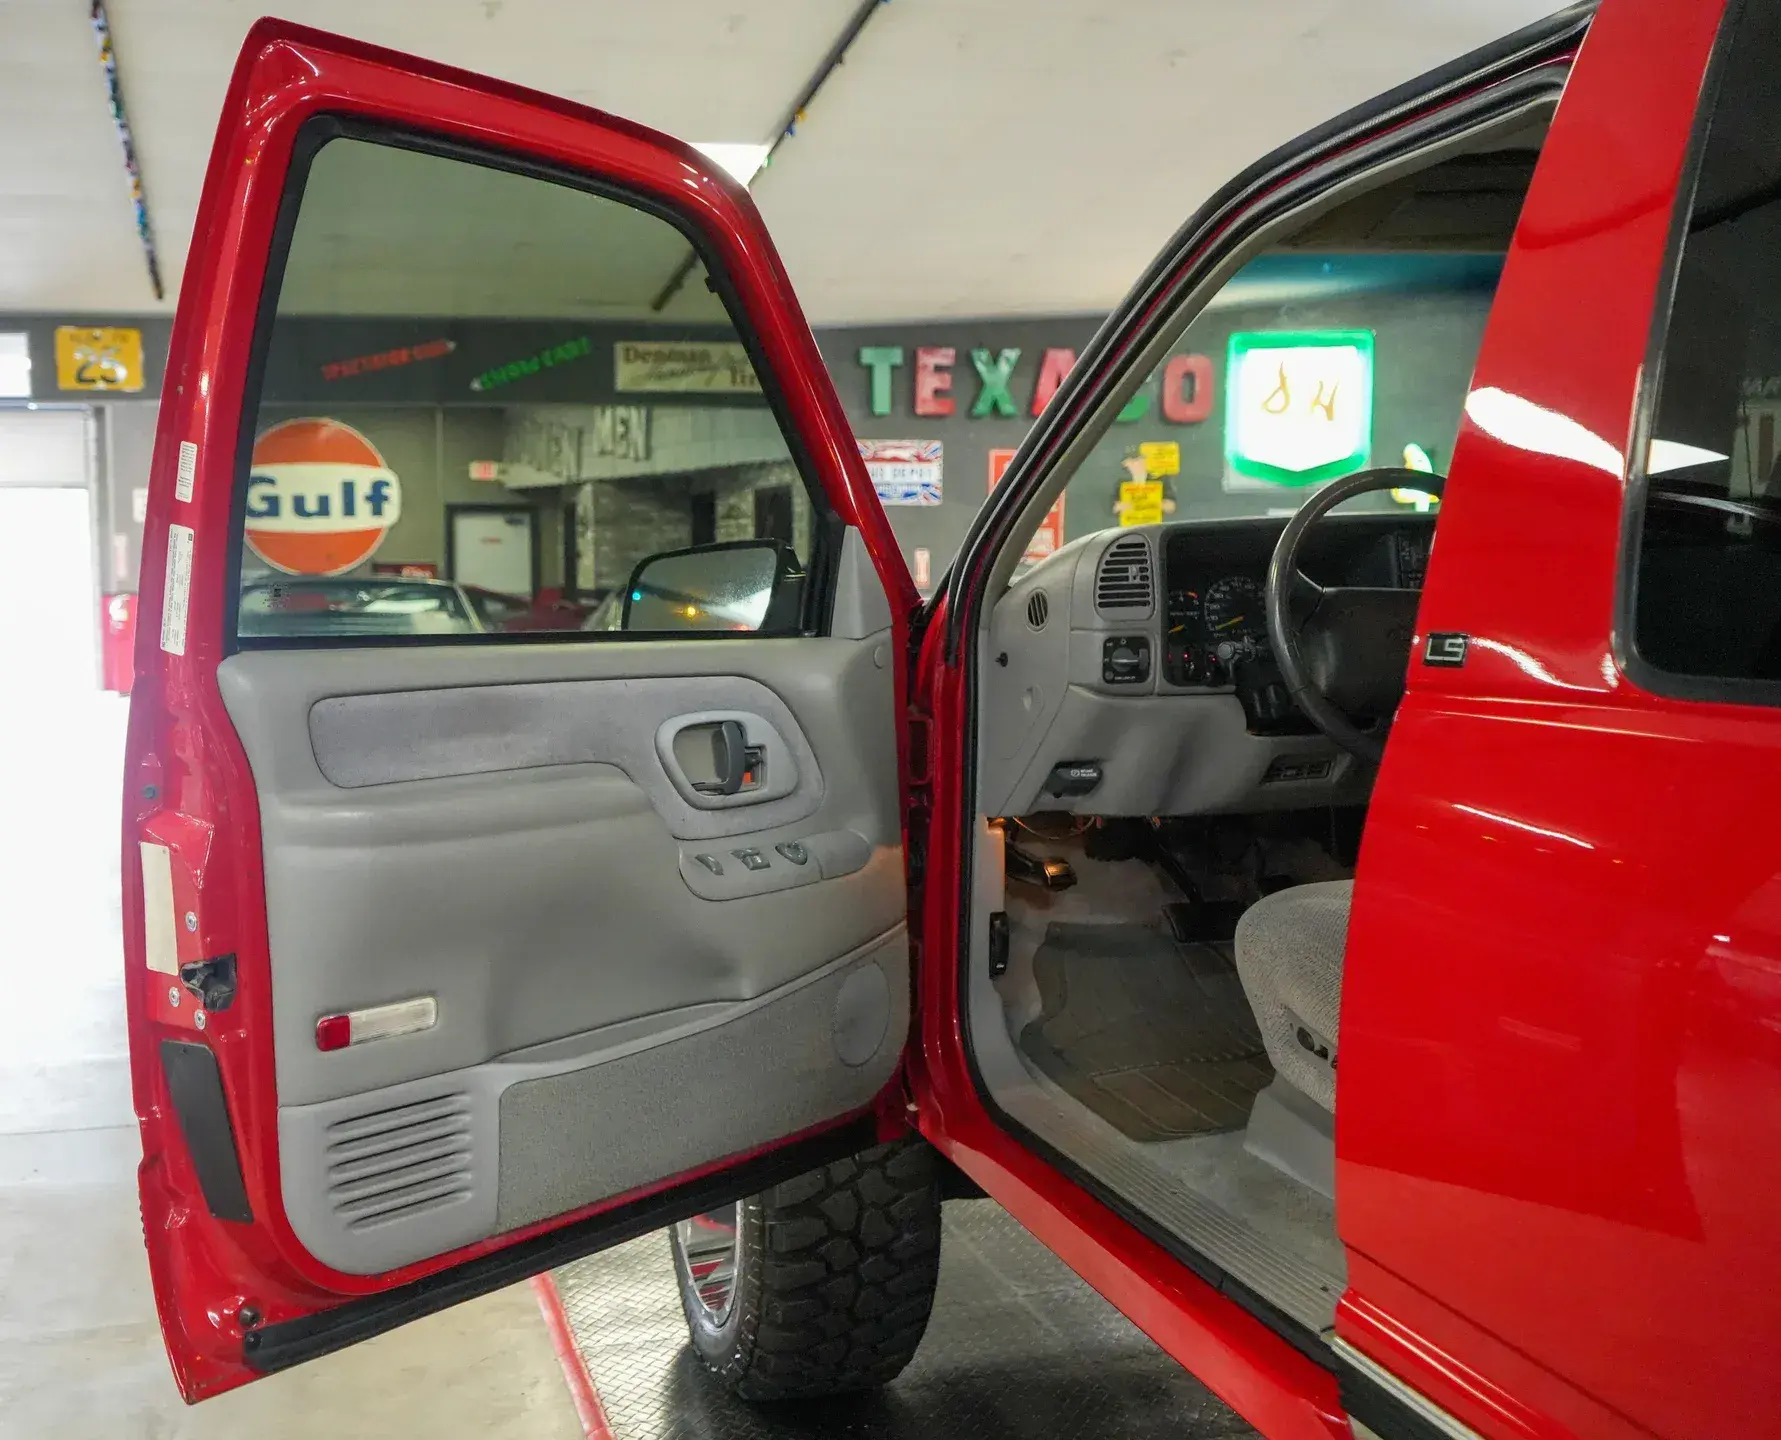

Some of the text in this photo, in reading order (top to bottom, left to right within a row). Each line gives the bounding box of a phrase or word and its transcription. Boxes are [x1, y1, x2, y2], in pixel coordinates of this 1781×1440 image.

[859, 346, 1214, 424] TEXAO
[246, 475, 390, 518] Gulf
[1426, 637, 1465, 662] LS
